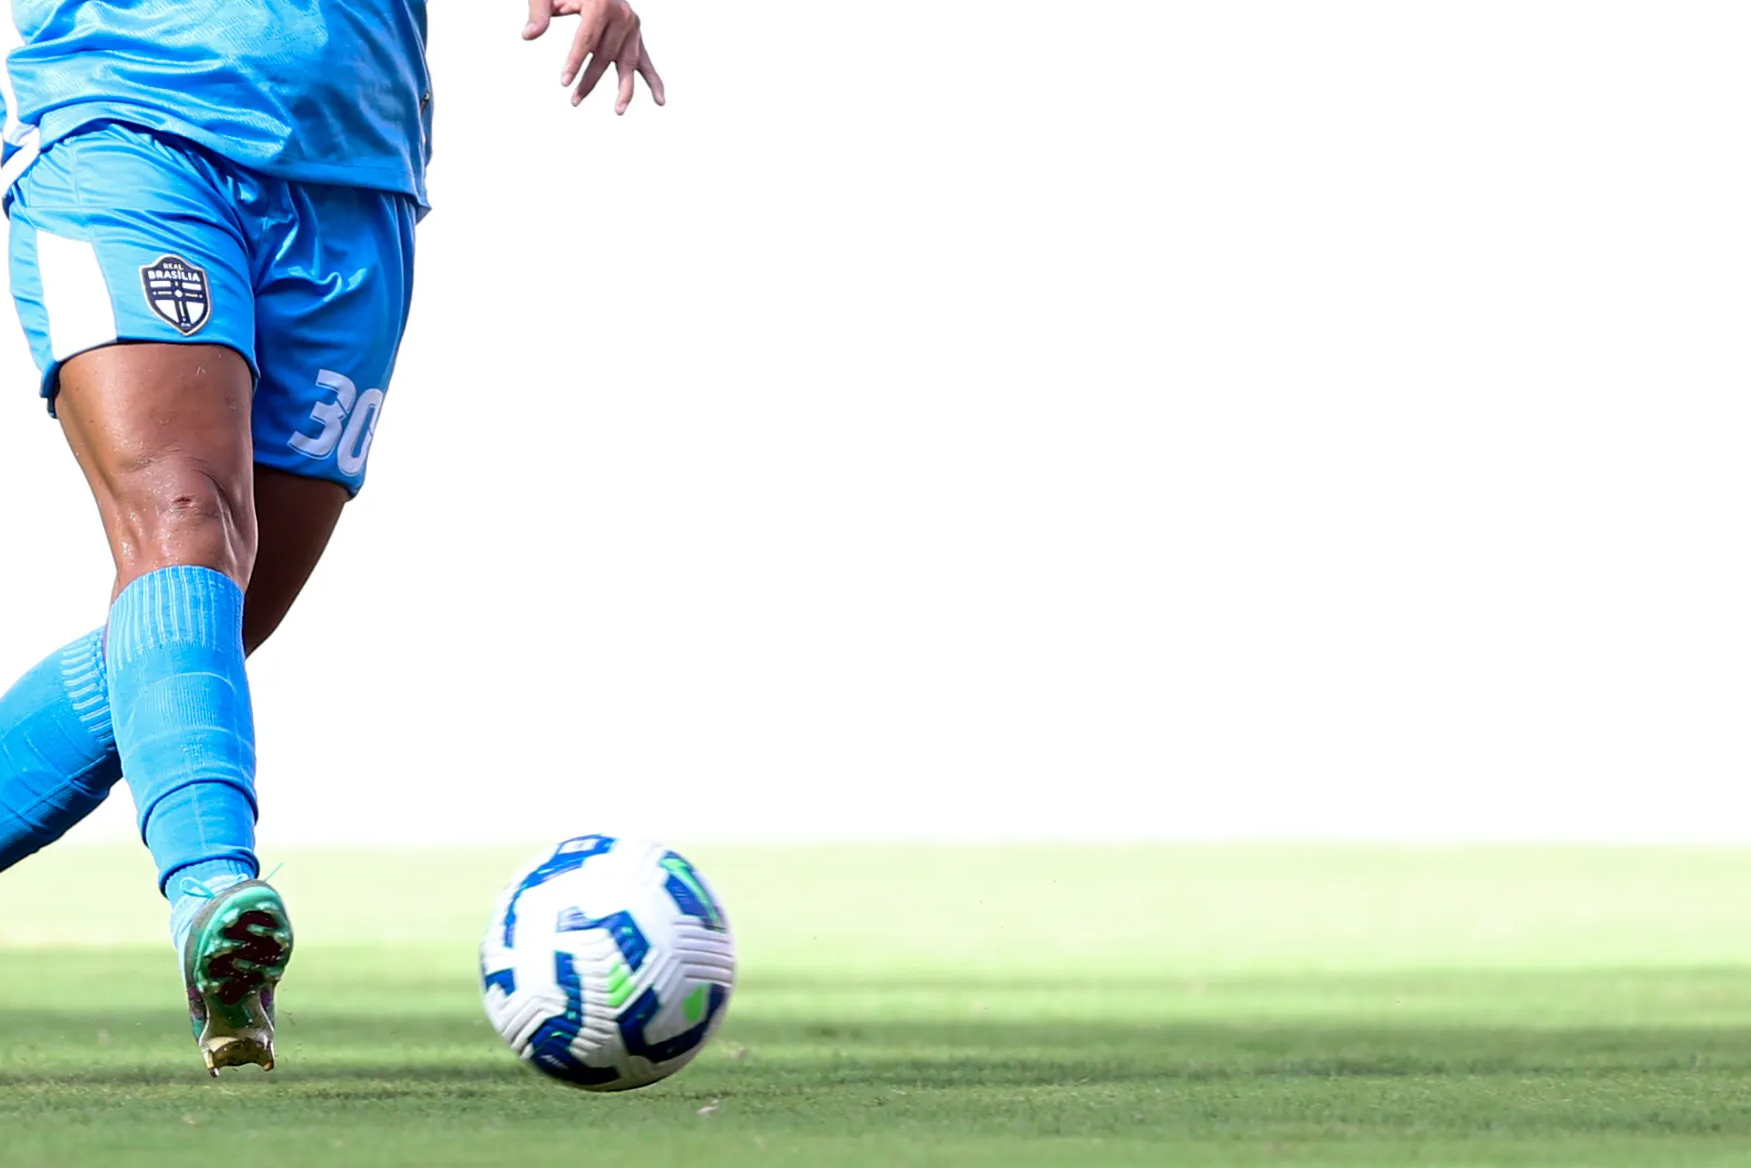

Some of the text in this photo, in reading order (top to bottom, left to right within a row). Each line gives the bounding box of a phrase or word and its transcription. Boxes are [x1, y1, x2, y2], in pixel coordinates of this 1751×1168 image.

[163, 262, 184, 270] REAL
[147, 269, 201, 282] BRASÍLIA
[287, 368, 384, 477] 30
